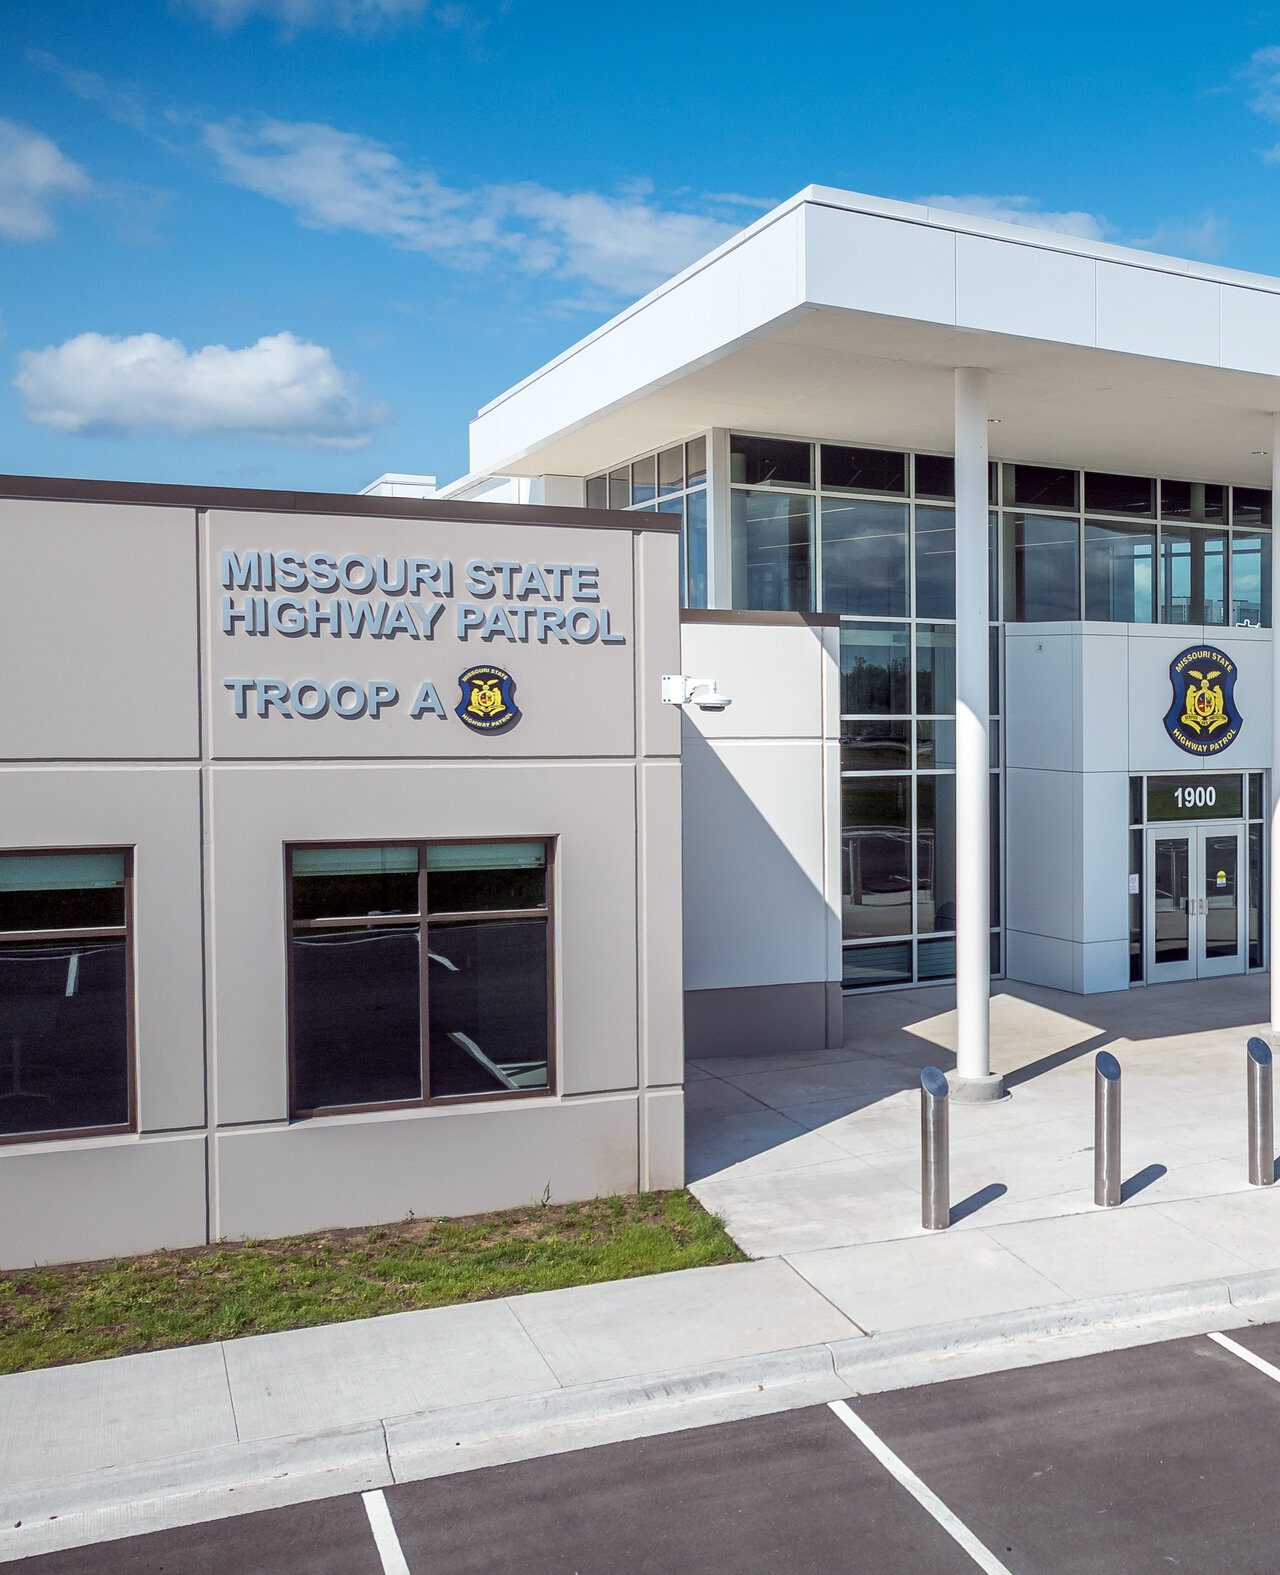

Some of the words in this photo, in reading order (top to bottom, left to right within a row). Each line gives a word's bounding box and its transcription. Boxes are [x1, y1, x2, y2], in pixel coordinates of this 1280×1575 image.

[221, 549, 453, 596] MISSOURI
[464, 559, 600, 601] STATE
[222, 596, 446, 639] HIGHWAY
[457, 603, 626, 643] PATROL
[1175, 650, 1210, 672] MISSOURI
[1211, 652, 1233, 672] STATE
[462, 668, 490, 682] MISSOURI
[491, 669, 509, 680] STATE
[223, 678, 399, 718] TROOP
[410, 680, 448, 719] A
[462, 713, 490, 727] HIGHWAY
[491, 713, 513, 727] PATROL
[1173, 728, 1208, 752] HIGHWAY
[1209, 729, 1237, 752] PATROL
[1174, 786, 1216, 808] 1900
